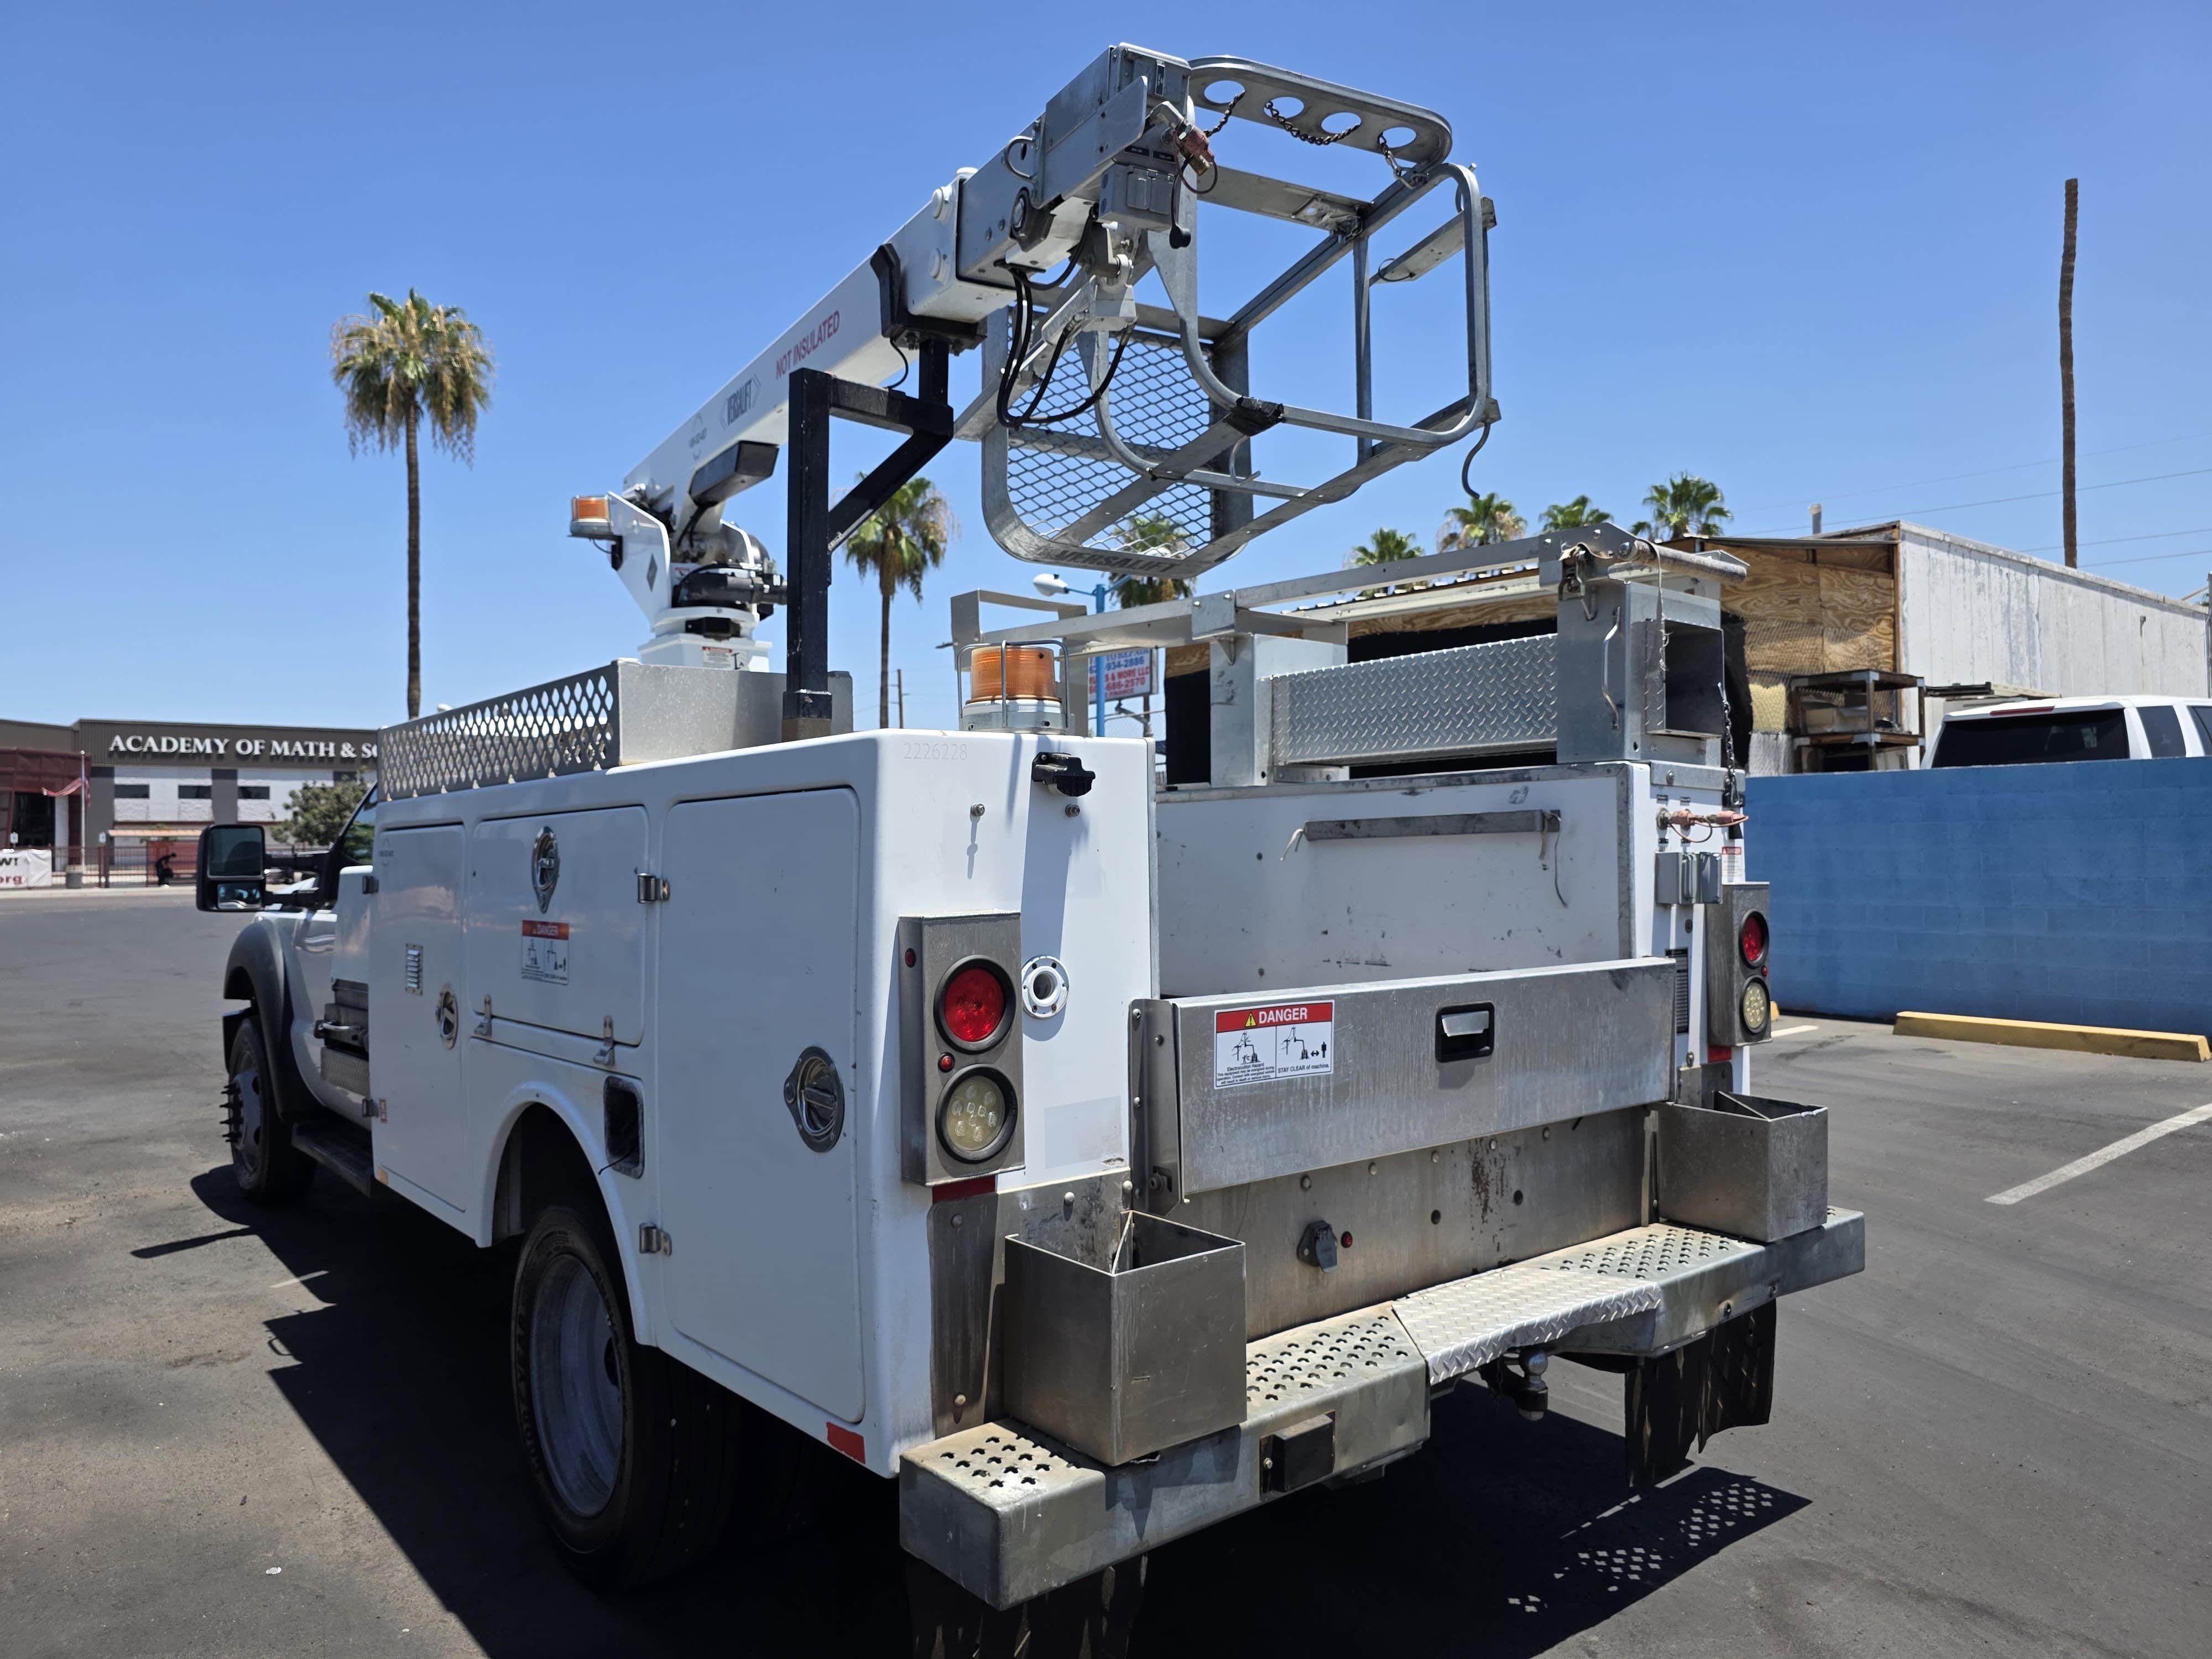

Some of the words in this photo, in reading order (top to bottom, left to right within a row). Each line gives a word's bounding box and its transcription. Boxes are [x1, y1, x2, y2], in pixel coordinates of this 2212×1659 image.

[775, 349, 792, 380] NOT
[793, 310, 840, 367] INSULATED
[727, 378, 753, 426] VERSALIFT
[1055, 550, 1182, 572] VERSALIFT
[1137, 665, 1150, 676] LLC
[108, 734, 230, 754] ACADEMY
[235, 739, 266, 755] OF
[270, 740, 336, 757] MATH
[340, 742, 357, 759] &
[903, 742, 968, 760] 2226228
[537, 924, 559, 936] DANGER
[1259, 1007, 1308, 1024] DANGER
